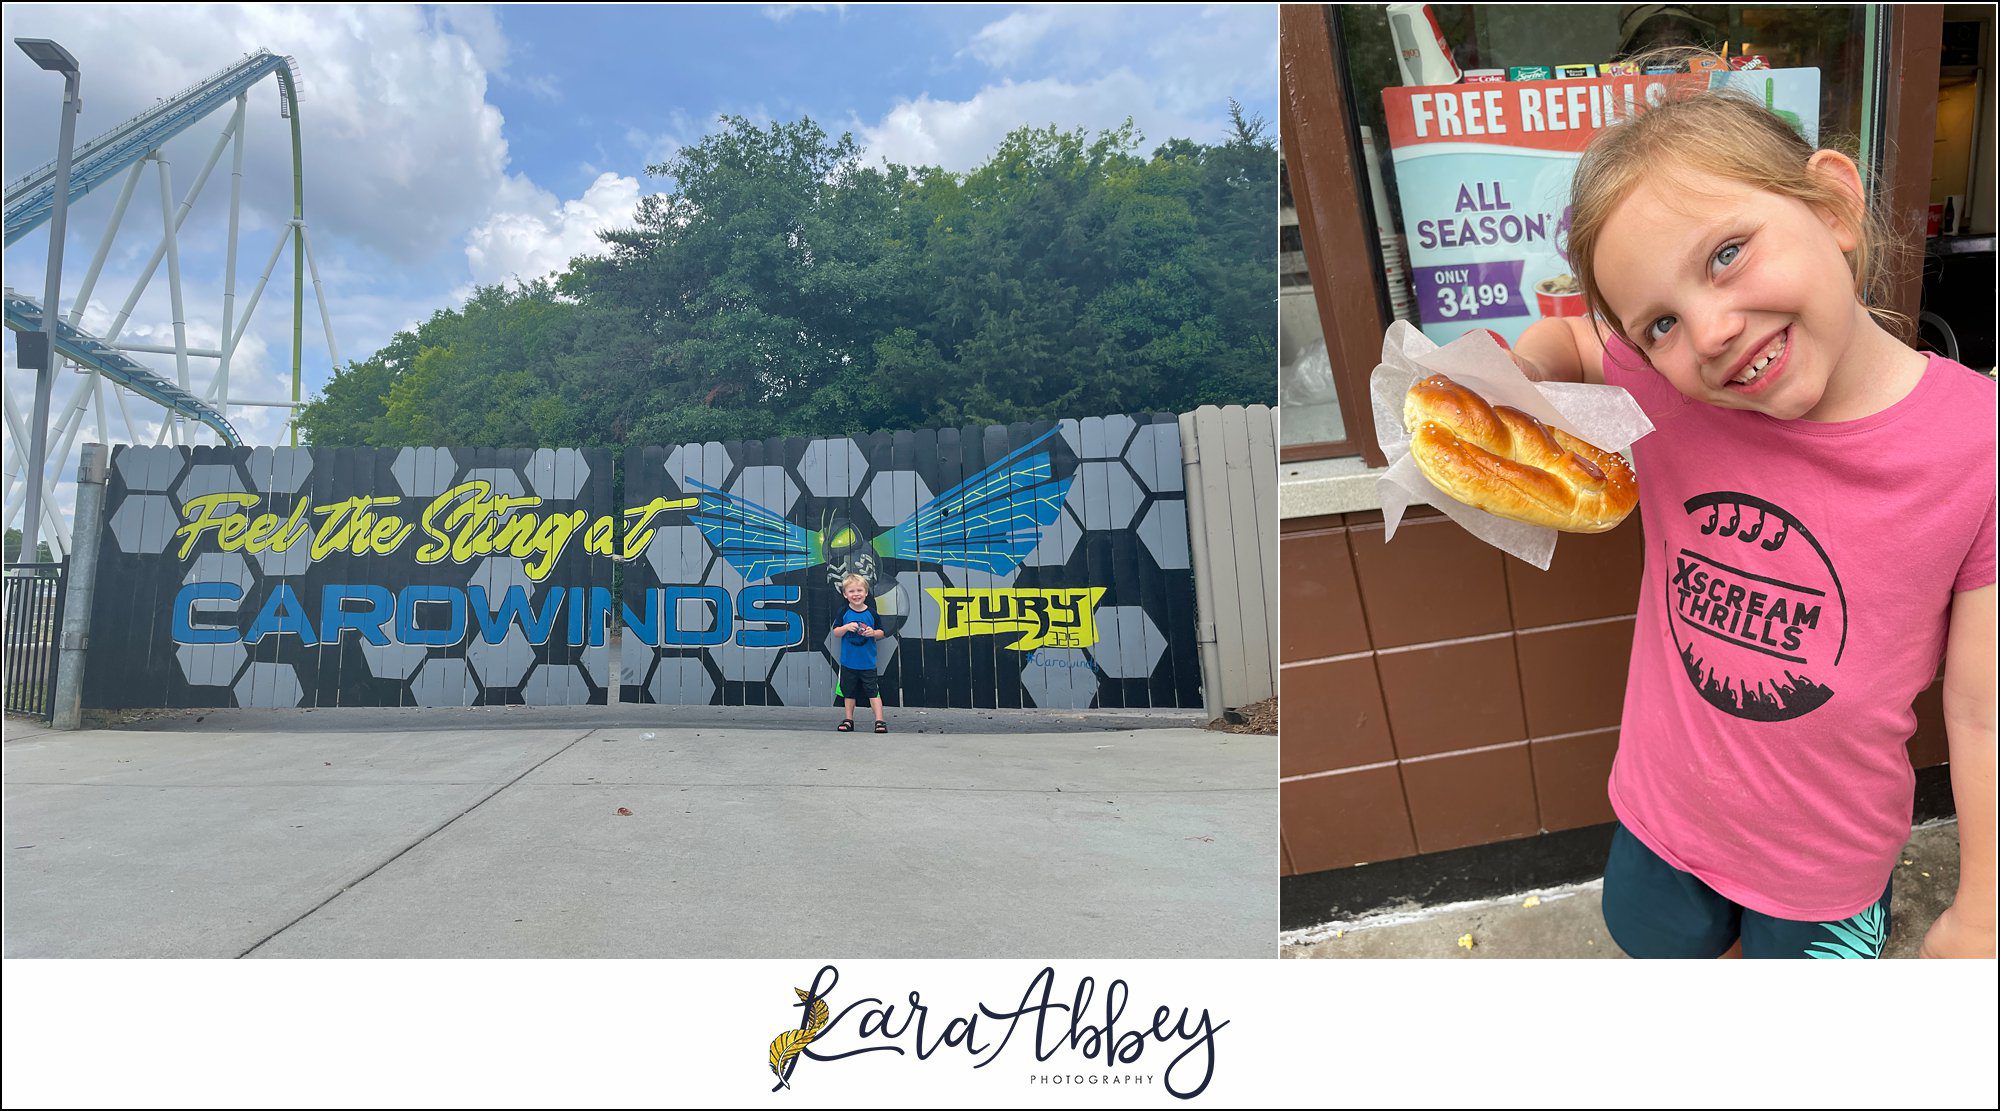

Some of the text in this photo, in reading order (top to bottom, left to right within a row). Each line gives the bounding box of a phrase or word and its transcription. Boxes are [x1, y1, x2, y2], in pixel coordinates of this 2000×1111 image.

[1478, 75, 1503, 83] Coke
[1518, 70, 1544, 81] Sprite
[1411, 90, 1507, 137] FREE
[1455, 182, 1511, 212] ALL
[1434, 269, 1469, 285] ONLY
[175, 481, 700, 583] Feel the Sting at
[172, 582, 804, 648] CAROWINDS
[1672, 557, 1822, 629] XSCREAM
[943, 594, 1088, 639] FURY
[1050, 631, 1080, 646] 325
[1677, 588, 1803, 651] THRILLS
